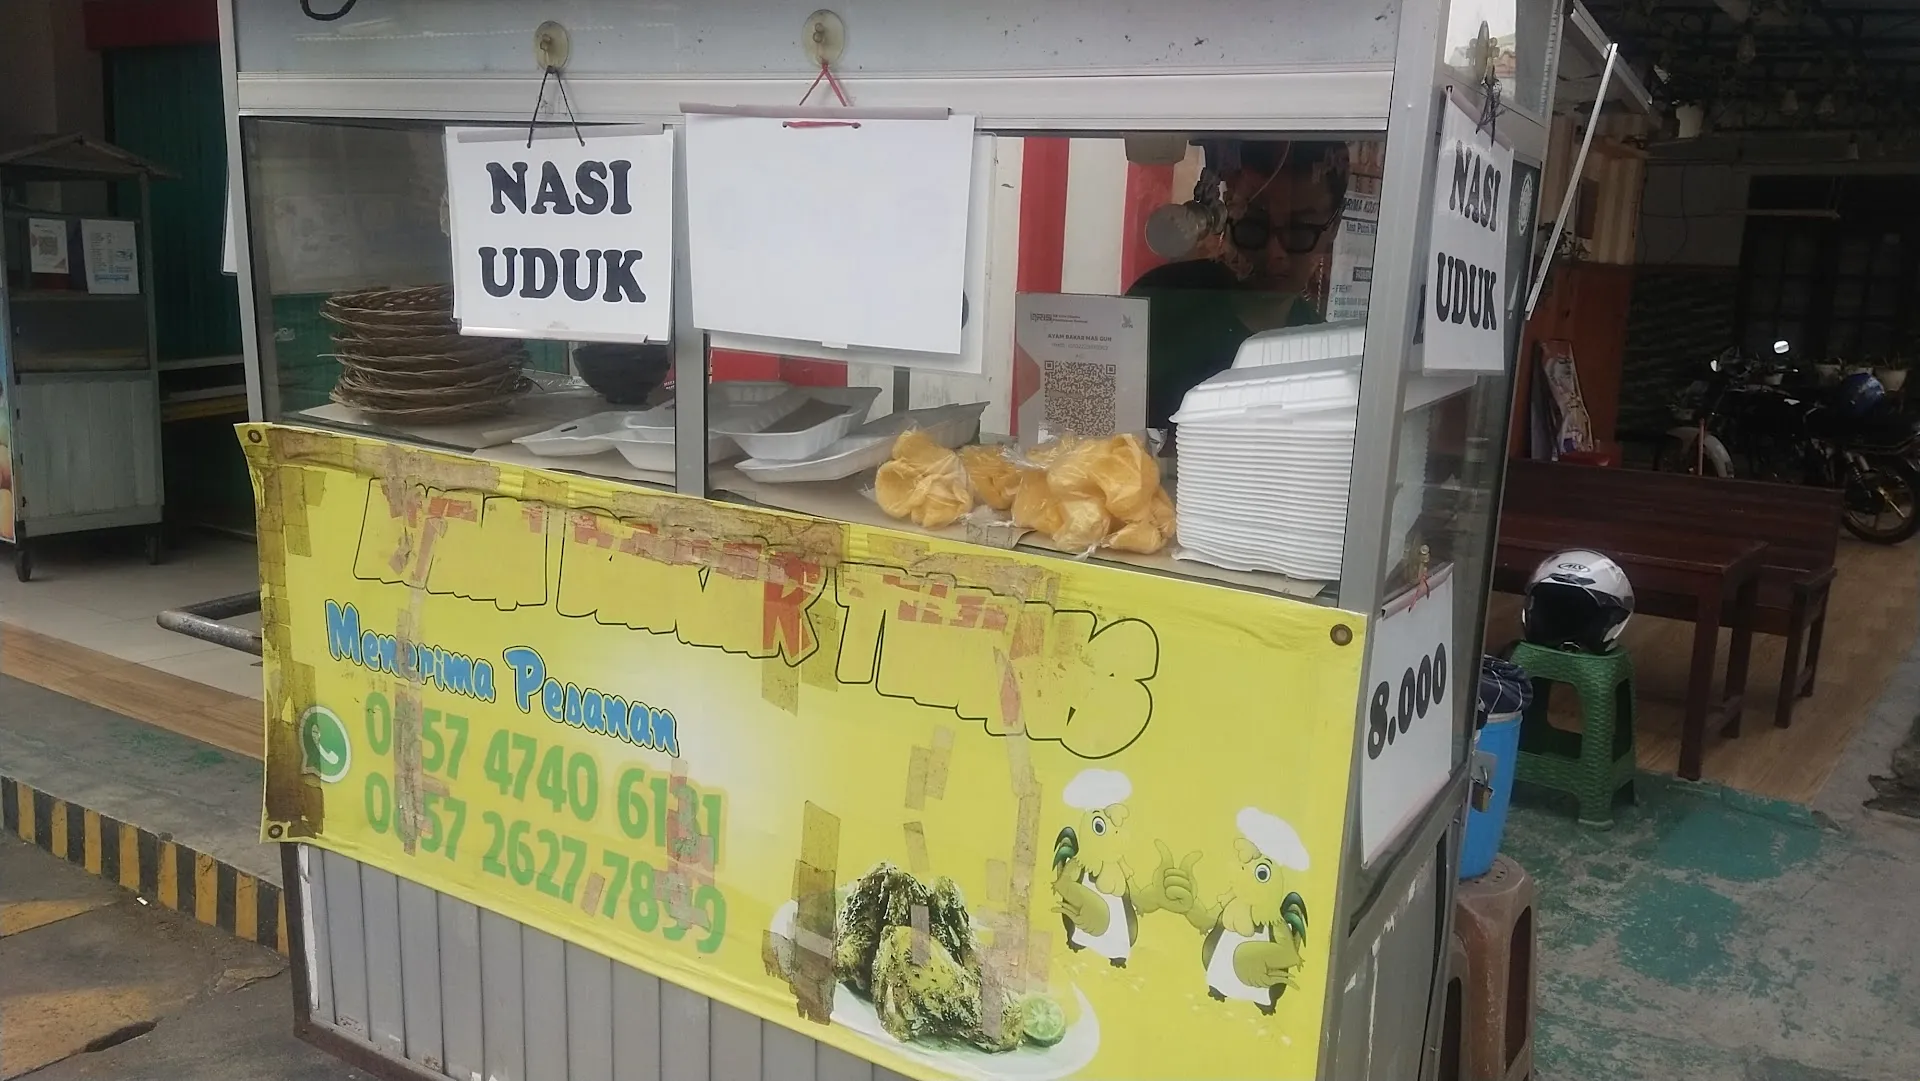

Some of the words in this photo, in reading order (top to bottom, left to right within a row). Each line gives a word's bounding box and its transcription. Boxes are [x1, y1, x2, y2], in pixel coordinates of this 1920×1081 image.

[485, 159, 632, 214] NASI
[1449, 140, 1502, 232] NASI
[478, 246, 646, 303] UDUK
[1436, 252, 1497, 331] UDUK
[325, 599, 496, 703] Menerima
[503, 645, 681, 758] Pesanan
[1368, 643, 1447, 760] 8.000
[365, 691, 469, 781] 057
[483, 728, 599, 823] 4740
[482, 810, 588, 905] 2627
